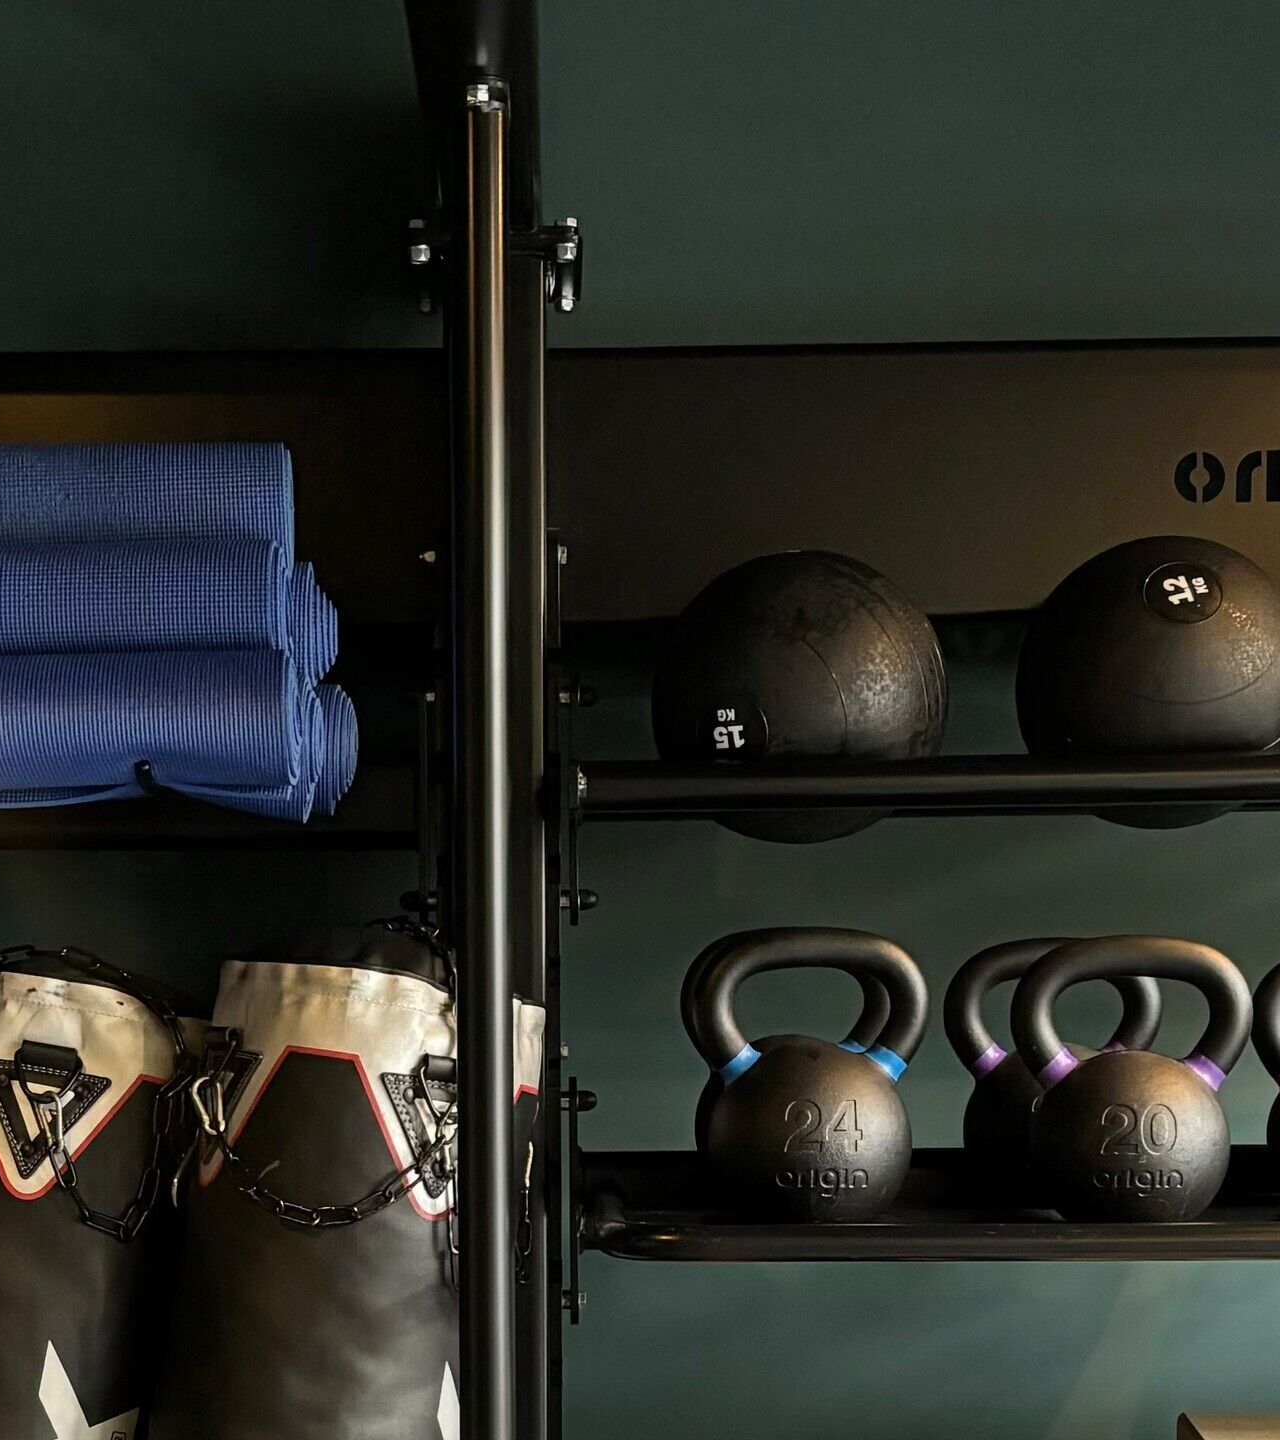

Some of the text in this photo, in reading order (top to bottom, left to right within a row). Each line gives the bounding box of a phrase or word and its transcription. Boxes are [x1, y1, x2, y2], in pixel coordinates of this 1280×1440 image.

[1162, 575, 1195, 605] 12
[1191, 576, 1209, 594] KG
[717, 708, 736, 721] KG
[713, 725, 745, 749] 15
[784, 1099, 864, 1153] 24
[1100, 1103, 1178, 1156] 20
[775, 1167, 869, 1199] origin
[1092, 1169, 1185, 1197] origin
